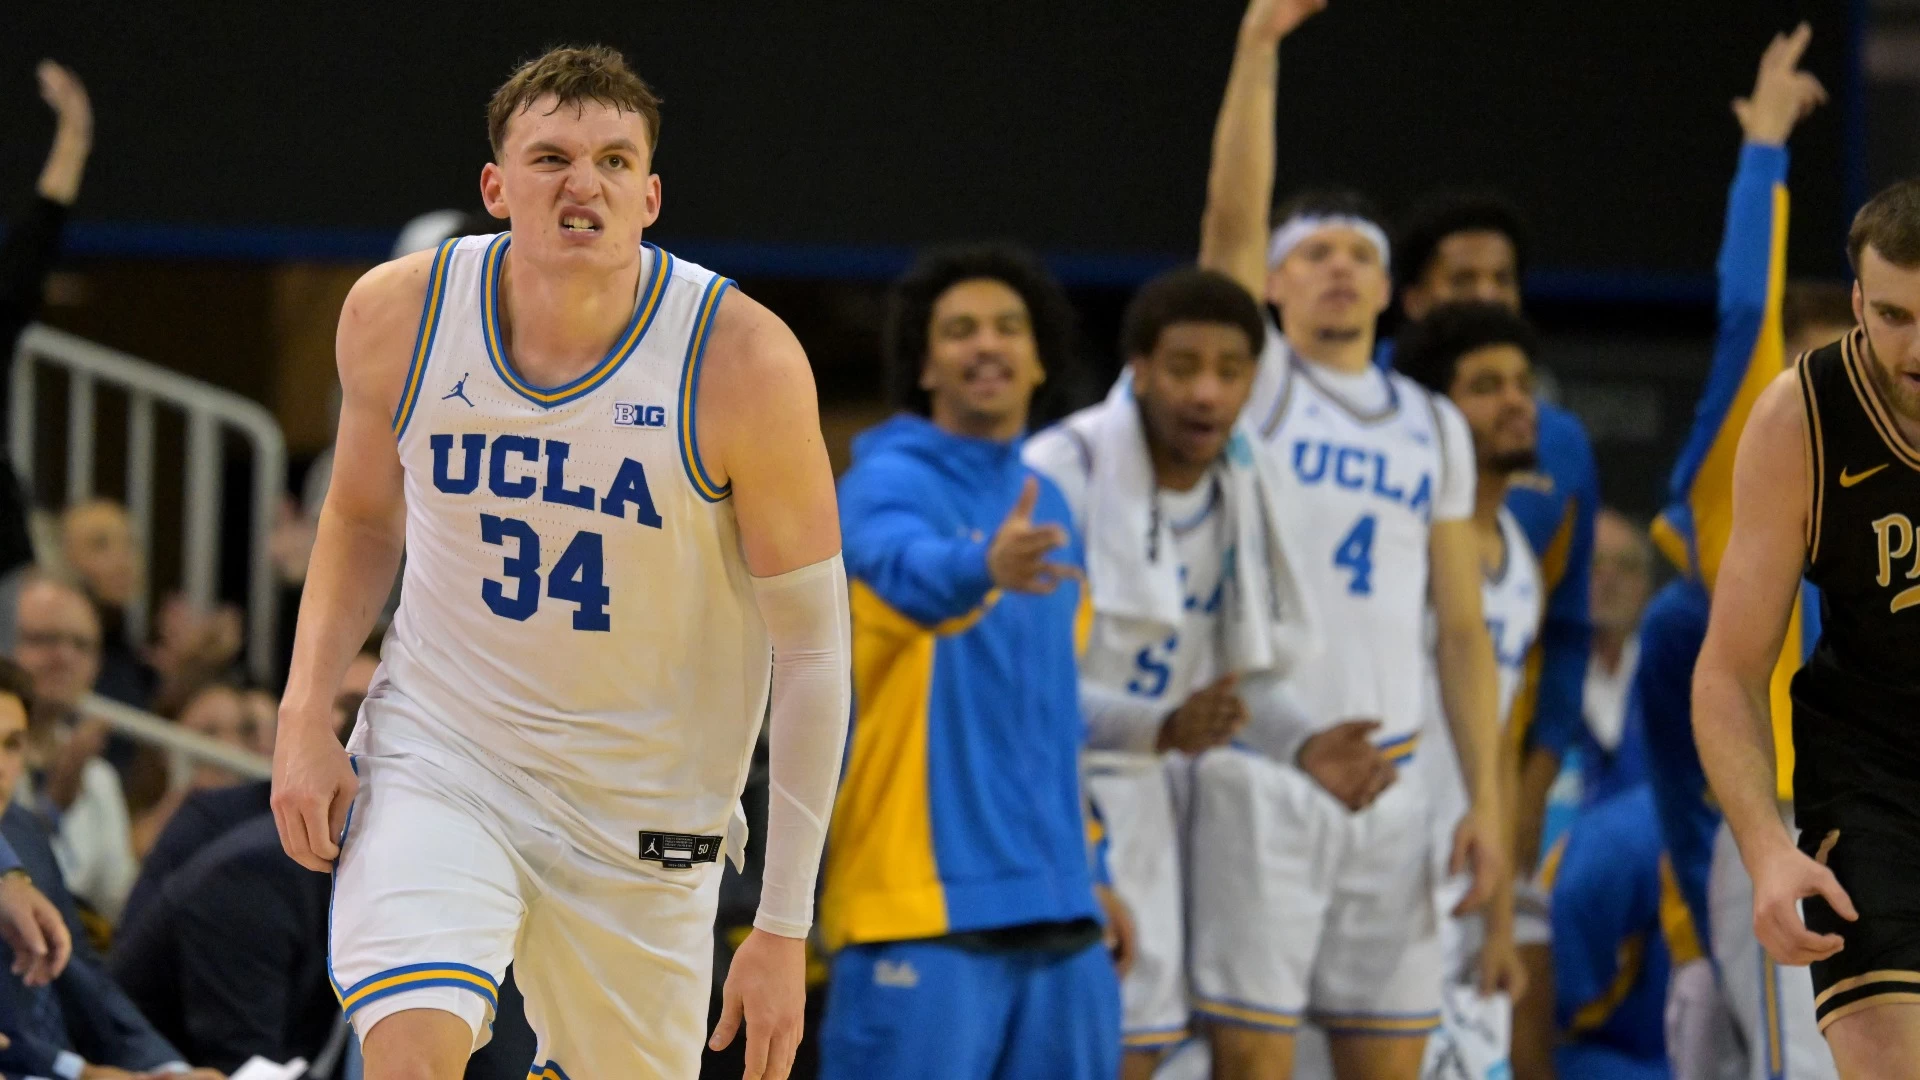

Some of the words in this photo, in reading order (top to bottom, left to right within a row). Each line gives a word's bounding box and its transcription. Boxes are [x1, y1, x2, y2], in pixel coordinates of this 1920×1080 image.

[430, 434, 662, 529] UCLA
[480, 513, 610, 632] 34
[1333, 513, 1377, 595] 4
[697, 843, 709, 855] 50
